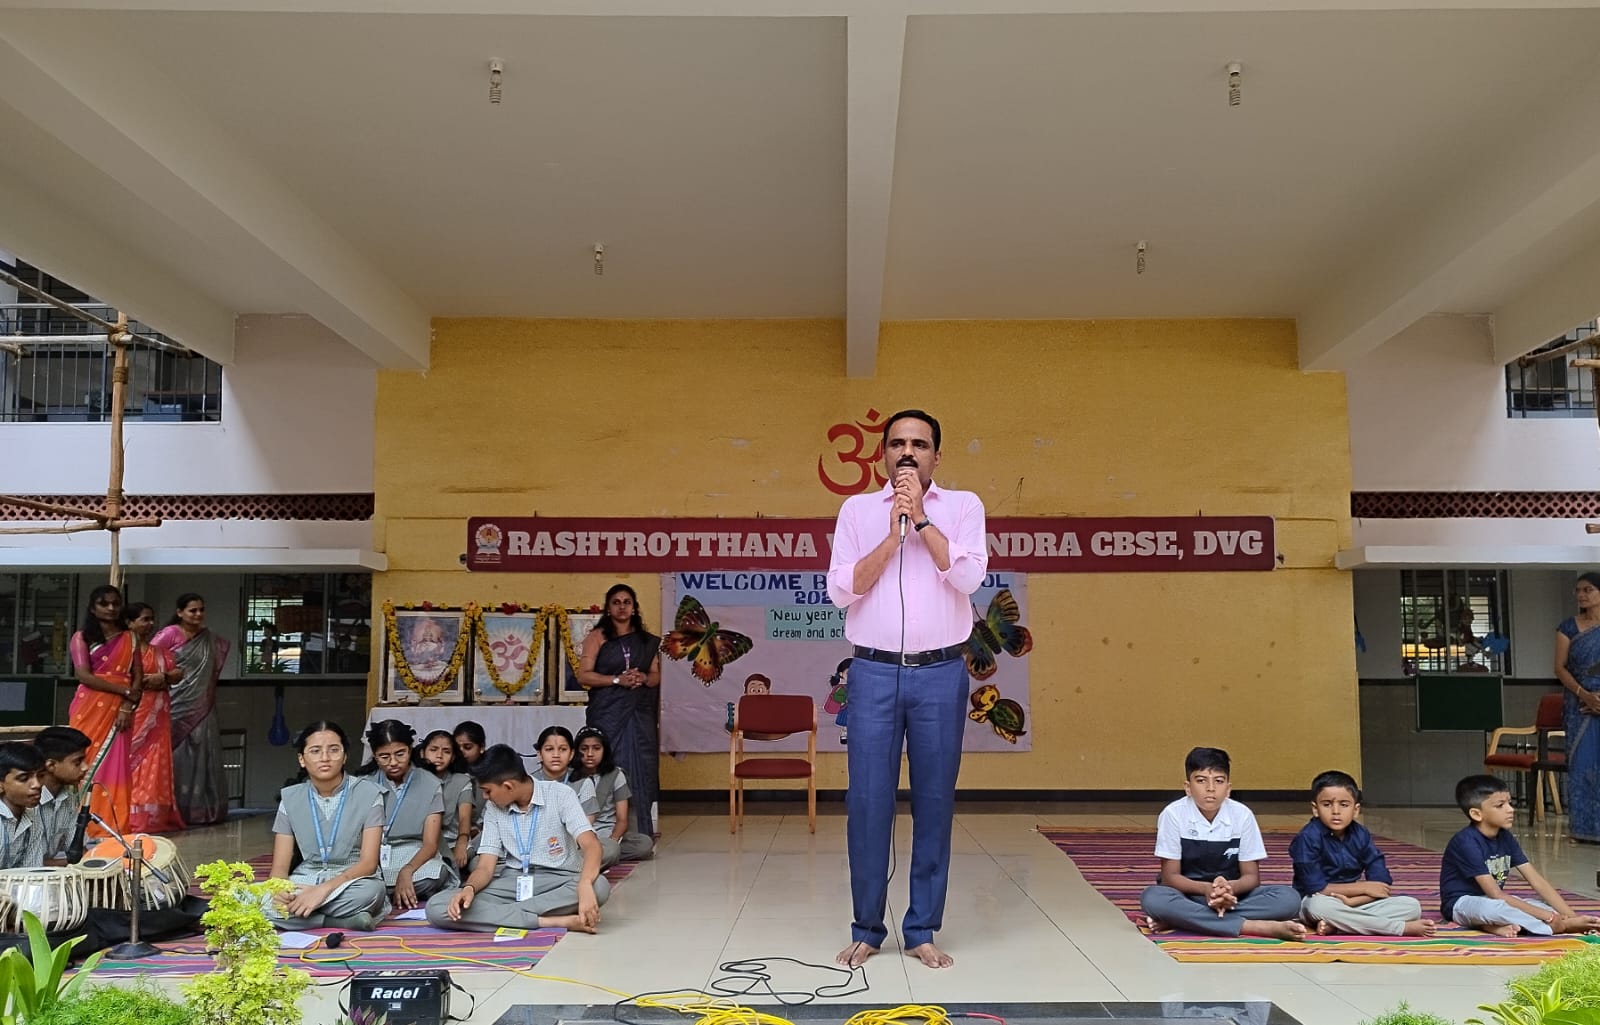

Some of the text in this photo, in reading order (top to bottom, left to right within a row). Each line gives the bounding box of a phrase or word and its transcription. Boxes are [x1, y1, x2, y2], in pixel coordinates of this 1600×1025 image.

[507, 530, 818, 558] RASHTROTTHANA
[985, 532, 1083, 557] NDRA
[1091, 531, 1184, 560] CBSE,
[1193, 530, 1264, 556] DVG
[681, 573, 802, 590] WELCOME
[805, 610, 834, 626] year
[772, 627, 802, 639] dream
[806, 627, 825, 639] and
[370, 987, 420, 999] Radel
